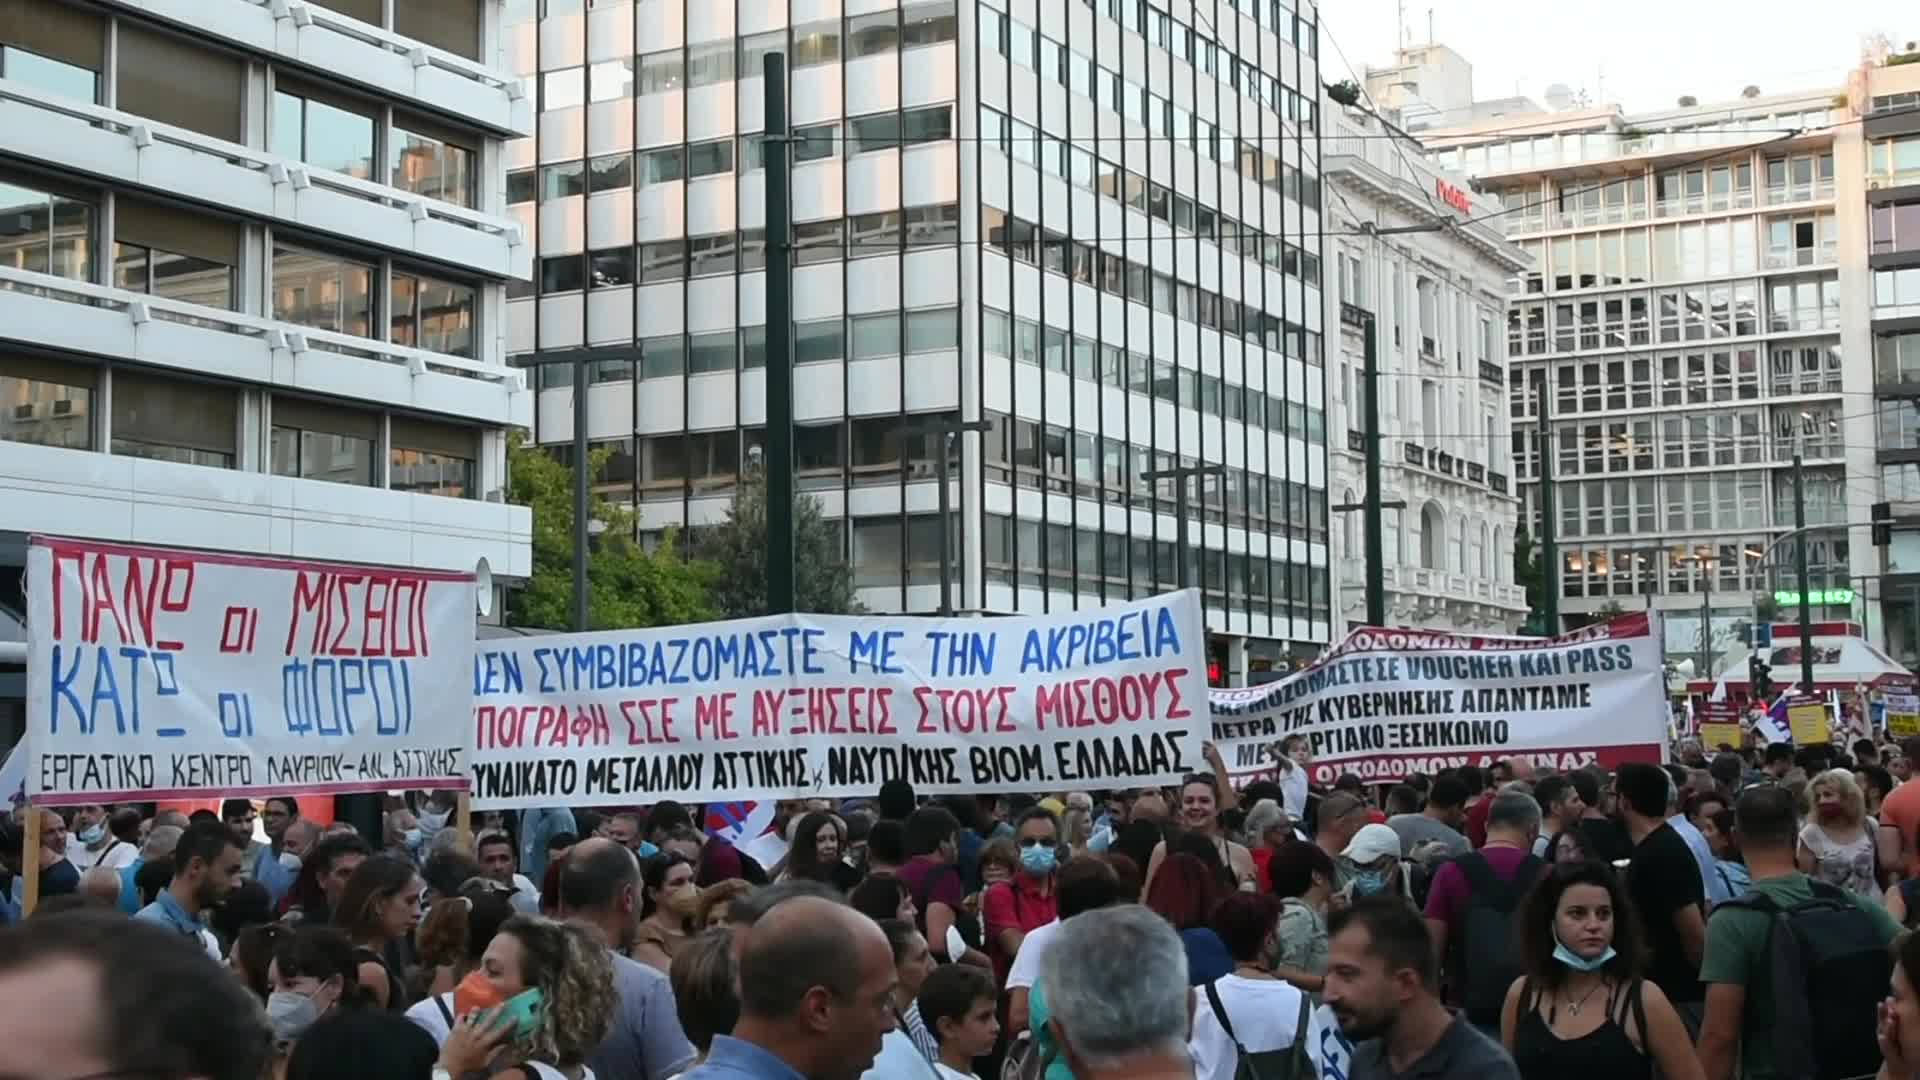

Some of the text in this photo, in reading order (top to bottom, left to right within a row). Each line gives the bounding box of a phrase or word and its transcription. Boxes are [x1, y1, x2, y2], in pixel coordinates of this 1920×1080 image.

[1435, 175, 1472, 215] Public
[285, 570, 429, 657] ΜΙΣΘΟΙ
[533, 628, 825, 693] ΣΥΜΒΙΒΑΖΟΜΑΣΤΕ
[849, 631, 904, 674] ΜΕ
[925, 631, 997, 677] ΤΗΝ
[1019, 606, 1181, 673] ΑΚΡΙΒΕΙΑ
[1376, 656, 1400, 681] ΣΕ
[1405, 654, 1514, 681] VOUCHER
[1519, 651, 1561, 678] ΚΑΙ
[1567, 643, 1633, 674] PASS
[282, 656, 412, 736] ΦΟΡΟΙ
[472, 668, 1191, 751] ΠΟΓΡΑΦΗ ΣΣΕ ΜΕ ΑΥΞΗΣΕΙΣ ΣΤΟΥΣ ΜΙΣΘΟΥΣ
[1281, 703, 1314, 732] ΤΗΣ
[1318, 688, 1454, 723] ΚΥΒΕΡΝΗΣΗΣ
[1460, 682, 1591, 713] ΑΠΑΝΤΑΜΕ
[1388, 719, 1509, 748] ΞΕΣΗΚΩΜΟ
[41, 752, 154, 791] ΕΡΓΑΤΙΚΟ
[172, 752, 252, 786] ΚΕΝΤΡΟ
[393, 747, 463, 777] ΑΤΤΙΚΗΣ
[585, 752, 703, 796] ΜΕΤΑΛΛΟΥ
[712, 747, 810, 790] ΑΤΤΙΚΗΣ
[968, 744, 1053, 784] ΒΙΟΜ.
[1056, 730, 1194, 780] ΕΛΛΑΔΑΣ
